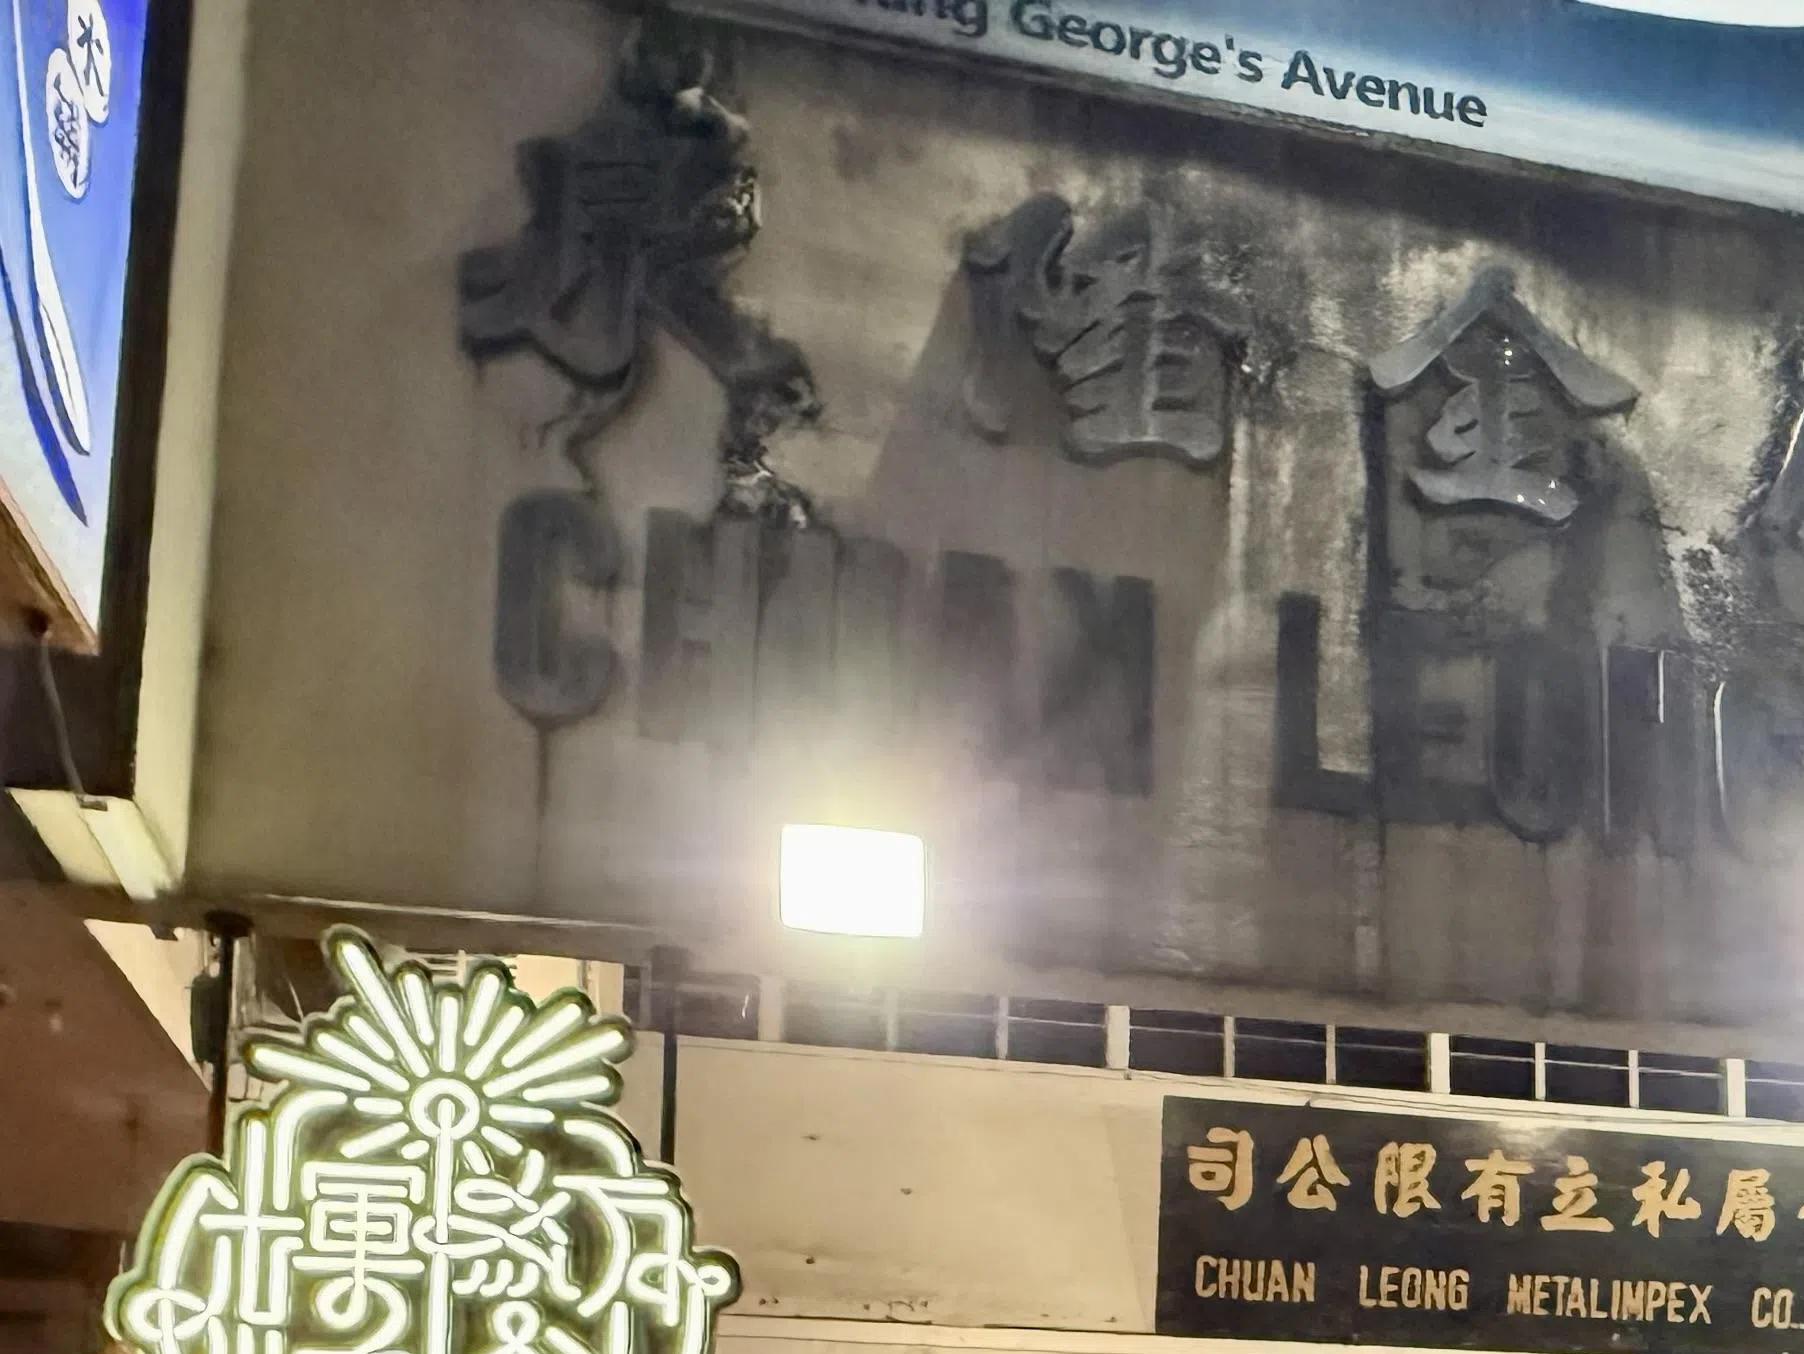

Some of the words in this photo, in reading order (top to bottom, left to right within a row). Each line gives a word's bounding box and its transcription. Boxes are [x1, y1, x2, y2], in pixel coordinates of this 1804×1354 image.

[1009, 0, 1267, 83] George's
[1282, 48, 1489, 129] Avenue
[1194, 1254, 1316, 1302] CHUAN
[1358, 1264, 1471, 1312] LEONG
[1507, 1273, 1713, 1325] METALIMPEX
